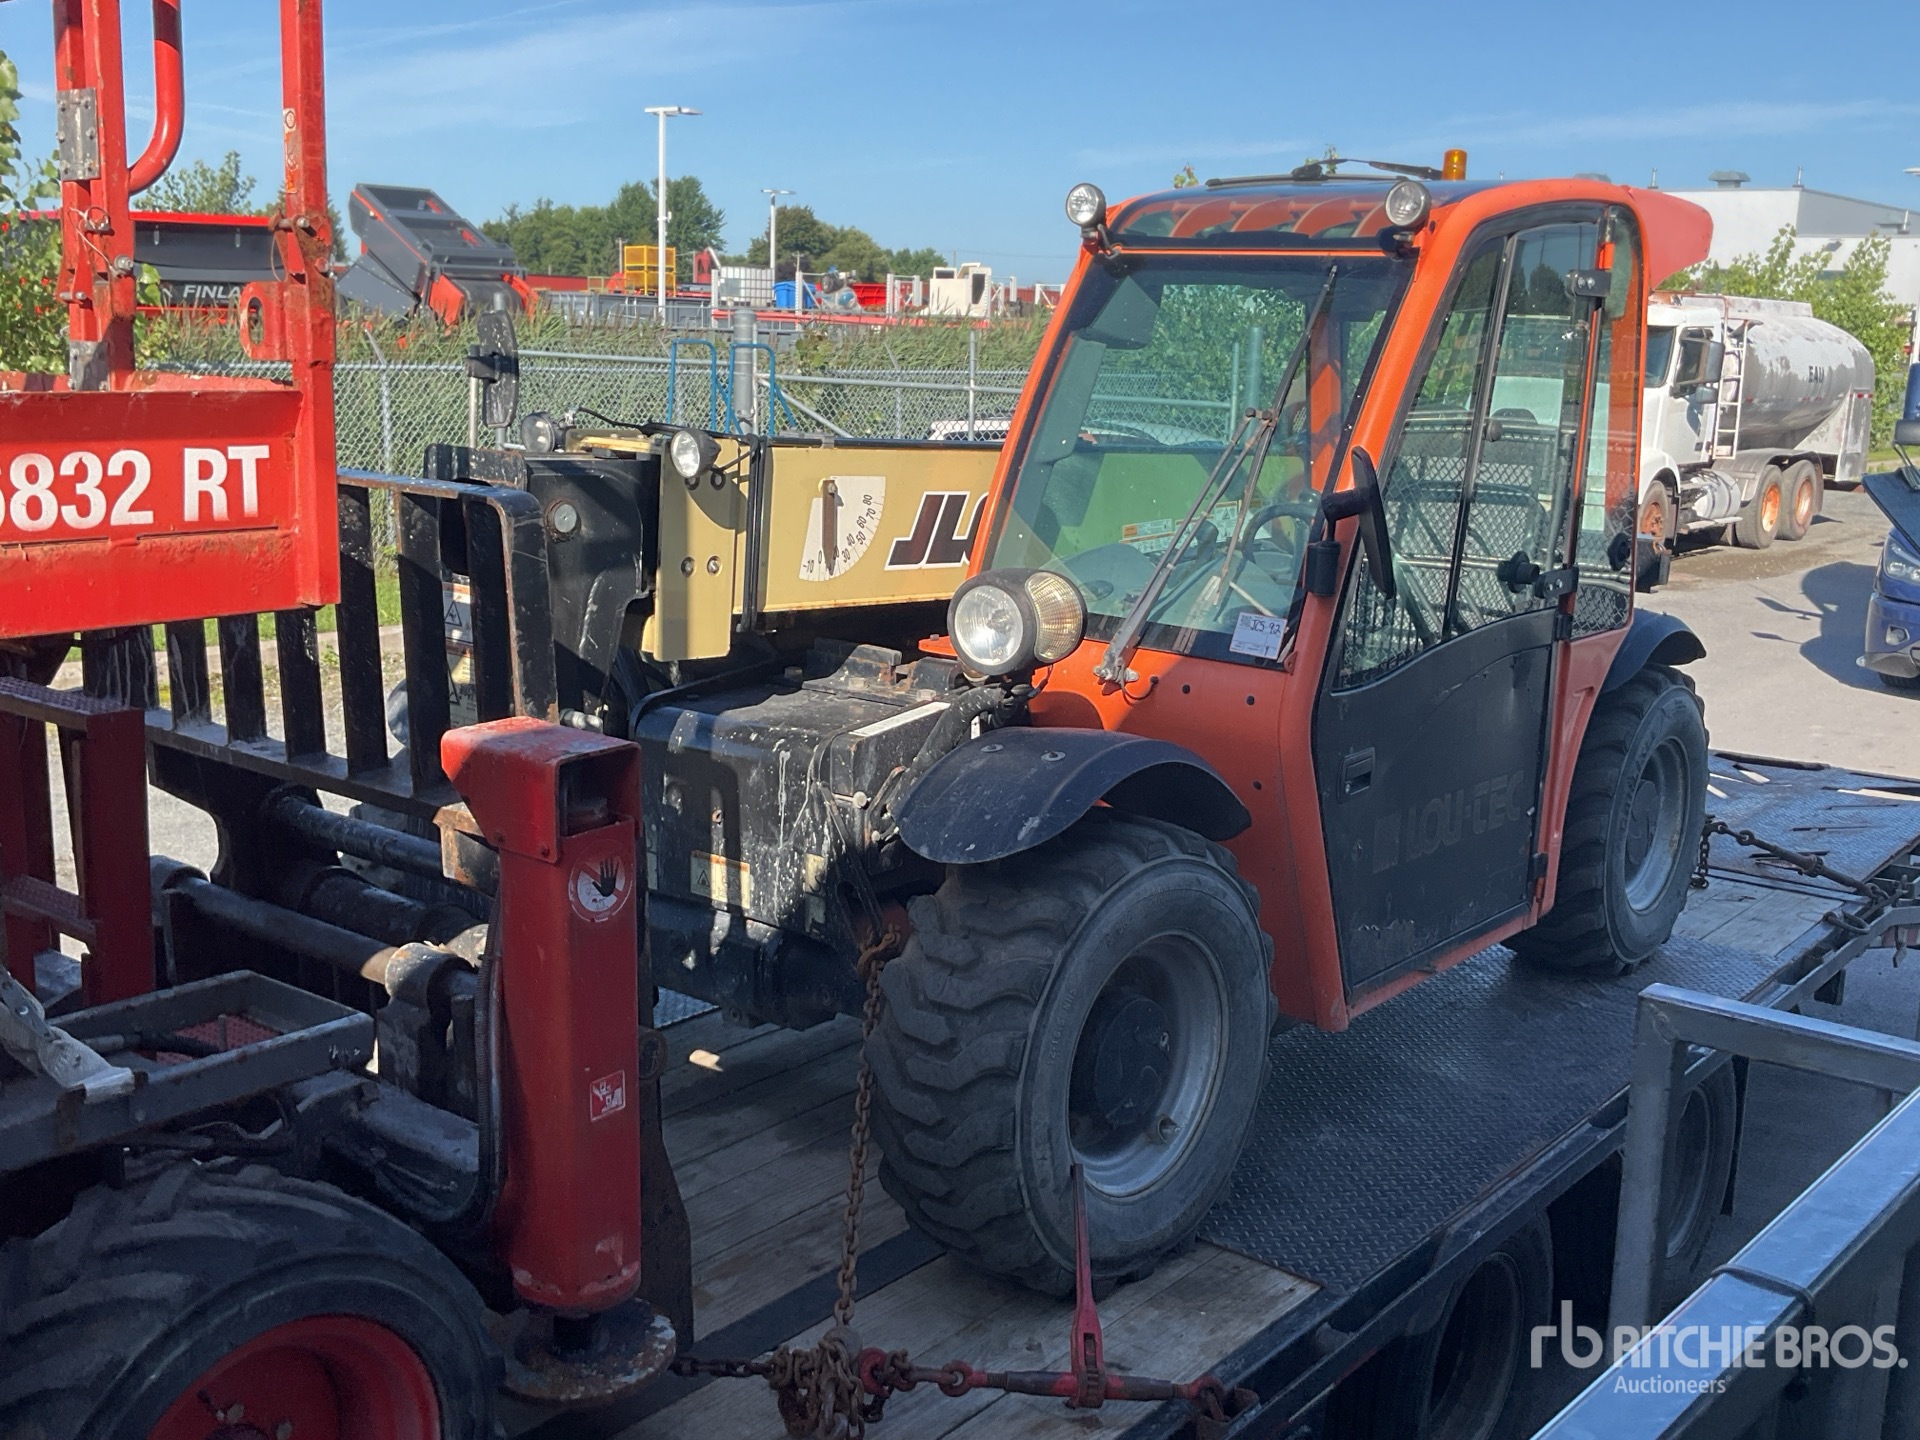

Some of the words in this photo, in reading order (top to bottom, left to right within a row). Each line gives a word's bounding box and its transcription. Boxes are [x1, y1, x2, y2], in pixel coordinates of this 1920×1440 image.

[183, 285, 241, 299] FINLA
[0, 449, 154, 532] 832
[184, 445, 270, 522] RT
[862, 494, 873, 506] 80
[865, 508, 876, 520] 70
[856, 515, 867, 529] 60
[846, 533, 855, 546] 40
[855, 531, 866, 545] 50
[818, 550, 823, 564] 0
[841, 548, 850, 563] 30
